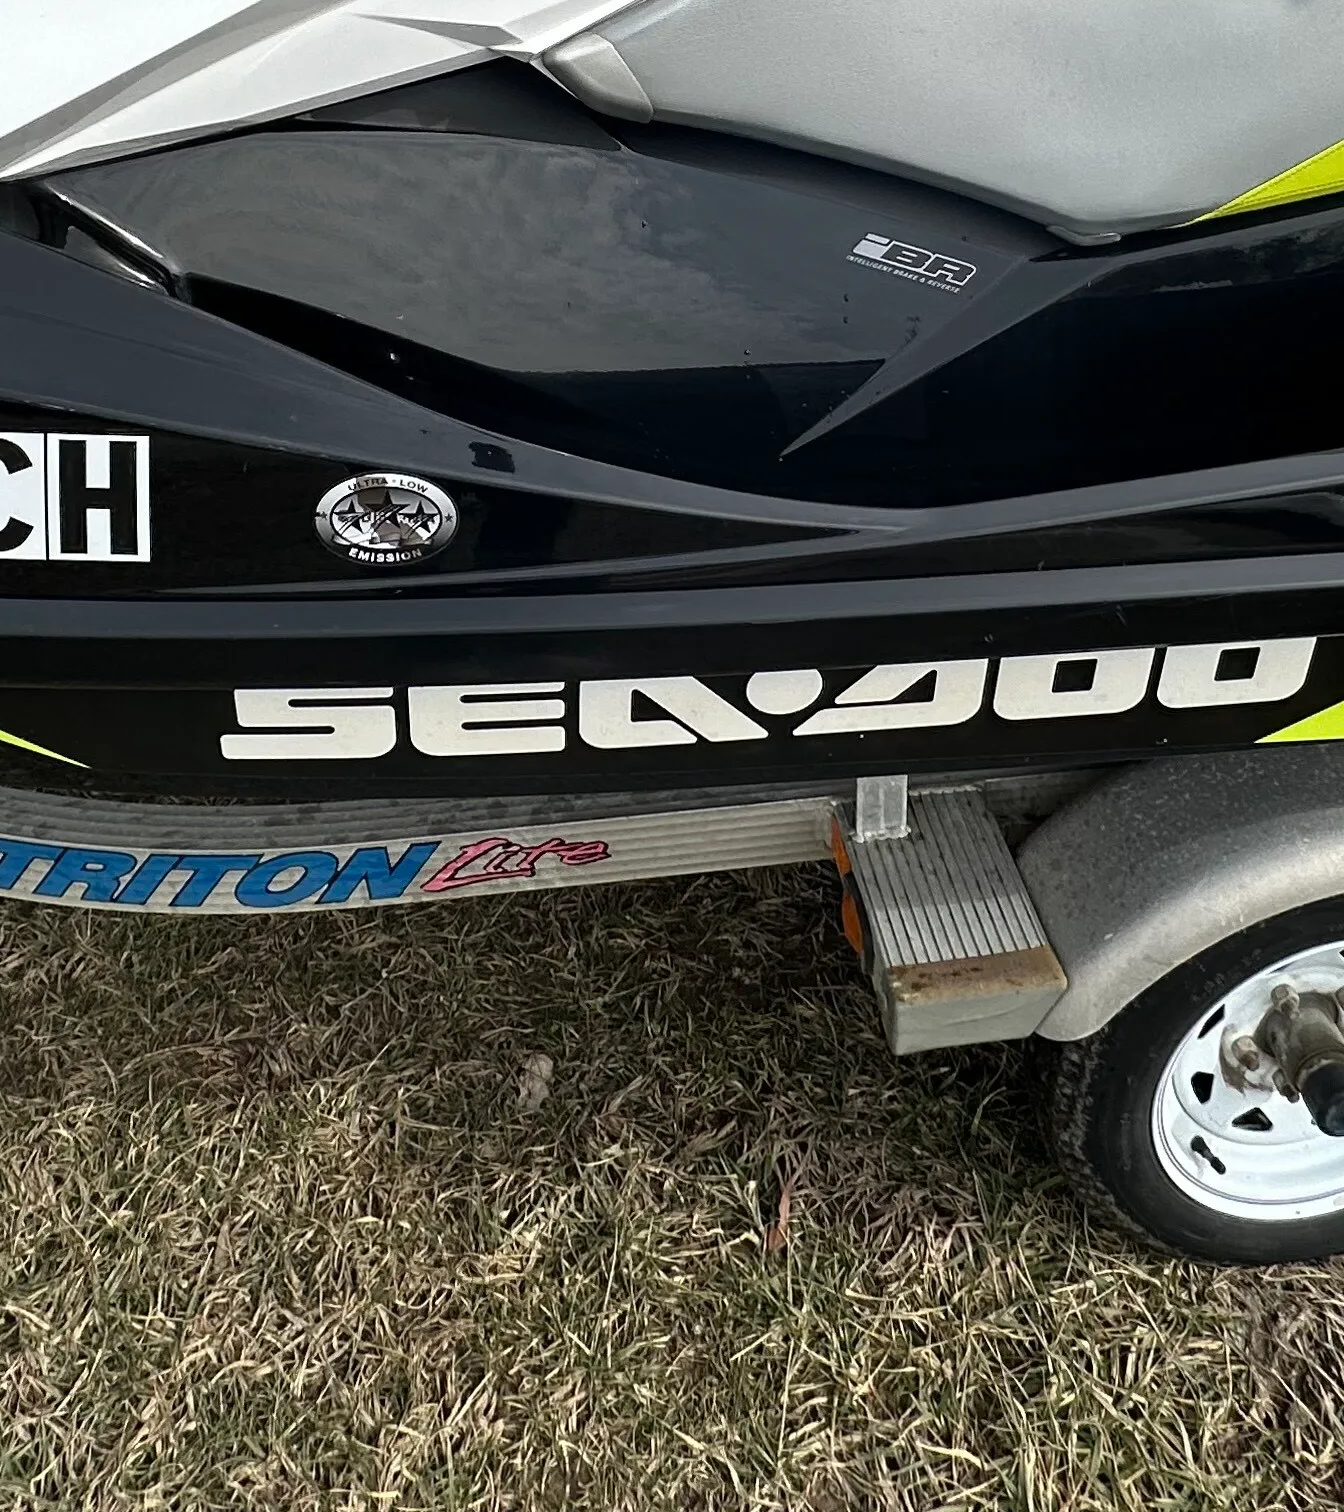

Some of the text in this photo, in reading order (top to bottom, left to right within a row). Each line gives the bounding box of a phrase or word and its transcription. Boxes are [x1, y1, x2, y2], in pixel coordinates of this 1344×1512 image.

[347, 476, 428, 493] ULTRA LOW
[348, 546, 423, 563] EMISSION
